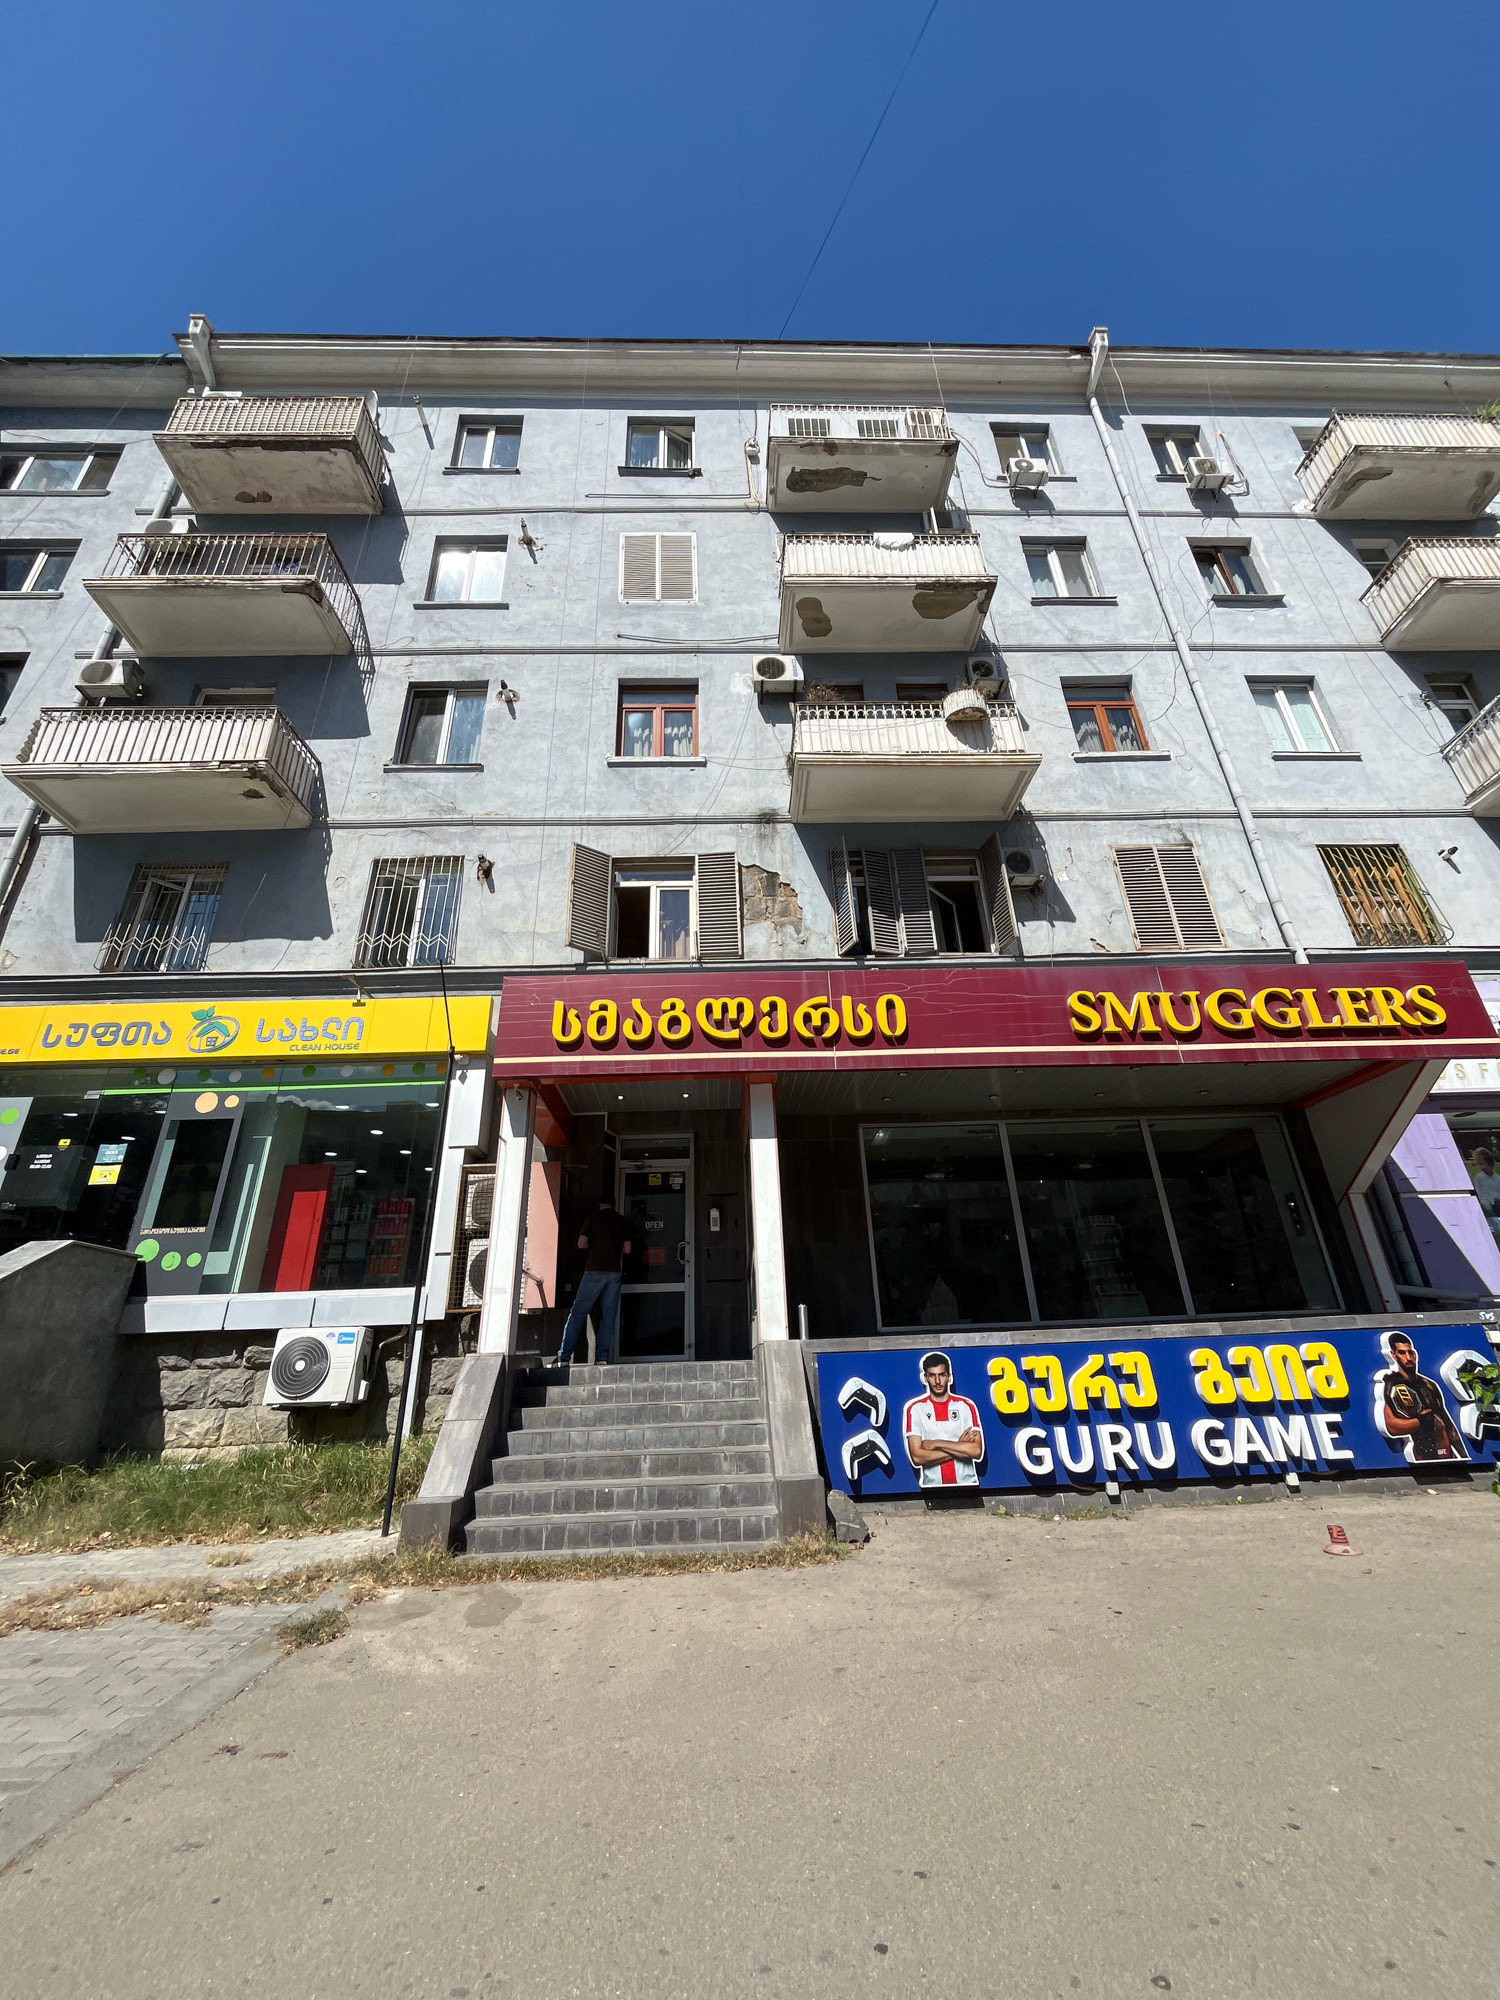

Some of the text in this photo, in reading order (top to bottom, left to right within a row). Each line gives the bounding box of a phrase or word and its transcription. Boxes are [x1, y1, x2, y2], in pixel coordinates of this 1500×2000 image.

[41, 1016, 365, 1048] სუფთა სახლი
[552, 994, 906, 1043] სმაგლერსი
[1067, 984, 1447, 1034] SMUGGLERS
[289, 1043, 360, 1052] CLEAN HOUSE
[645, 1220, 664, 1229] OPEN
[987, 1342, 1350, 1414] გურუ გეიმ
[1014, 1413, 1354, 1475] GURU GAME
